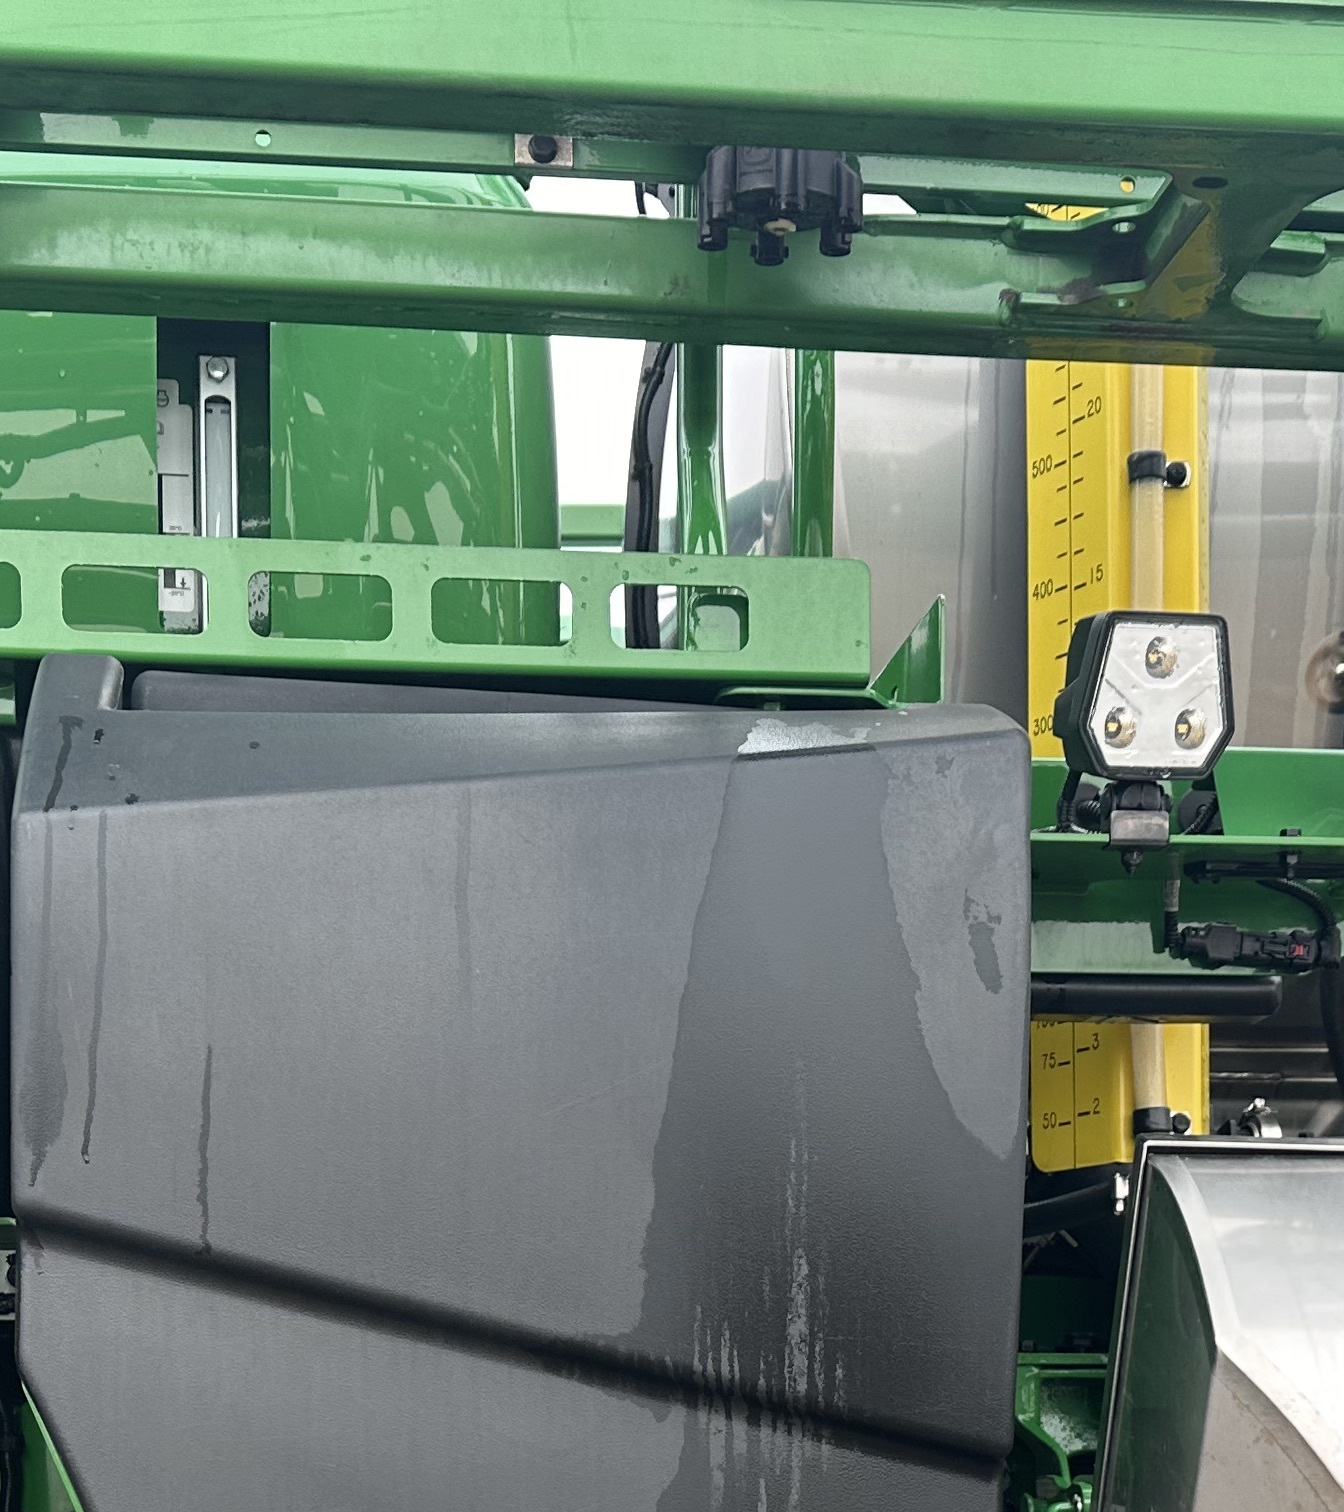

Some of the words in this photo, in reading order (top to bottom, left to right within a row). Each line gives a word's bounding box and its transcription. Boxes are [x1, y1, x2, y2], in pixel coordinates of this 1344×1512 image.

[1087, 397, 1102, 417] 20
[1032, 454, 1053, 478] 500
[1090, 564, 1104, 585] 15
[1032, 579, 1054, 600] 400
[1033, 715, 1055, 735] 300
[1092, 1033, 1100, 1050] 3
[1042, 1052, 1057, 1069] 75
[1093, 1098, 1101, 1115] 2
[1042, 1111, 1057, 1130] 50
